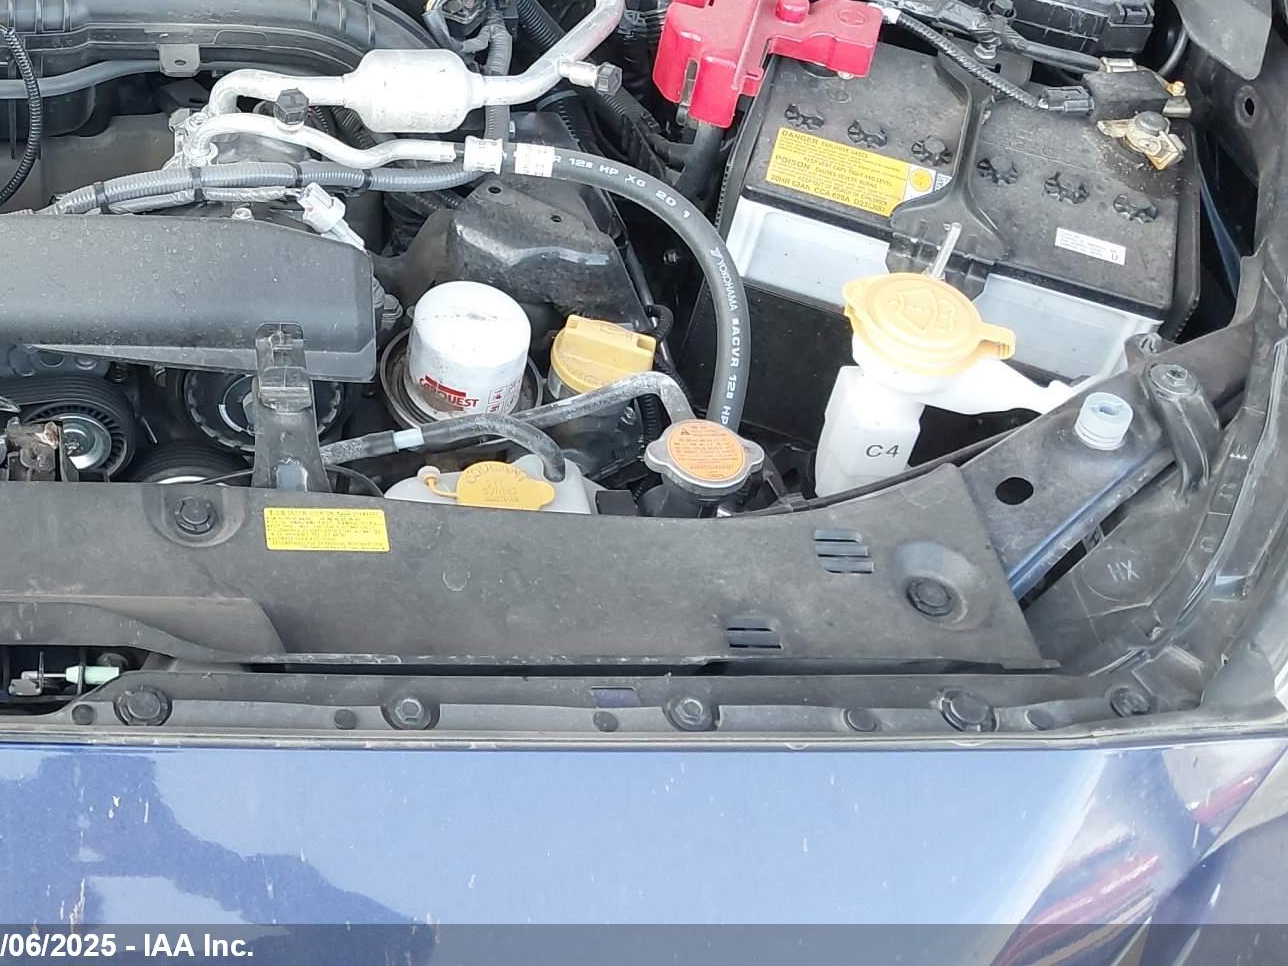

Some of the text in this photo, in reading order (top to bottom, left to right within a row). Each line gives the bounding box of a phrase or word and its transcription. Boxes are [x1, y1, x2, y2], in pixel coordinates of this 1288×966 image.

[781, 129, 818, 144] DANGER
[775, 154, 810, 169] POISON
[813, 186, 831, 196] CCA
[716, 258, 739, 311] YOKOHAMA
[866, 444, 899, 458] C4
